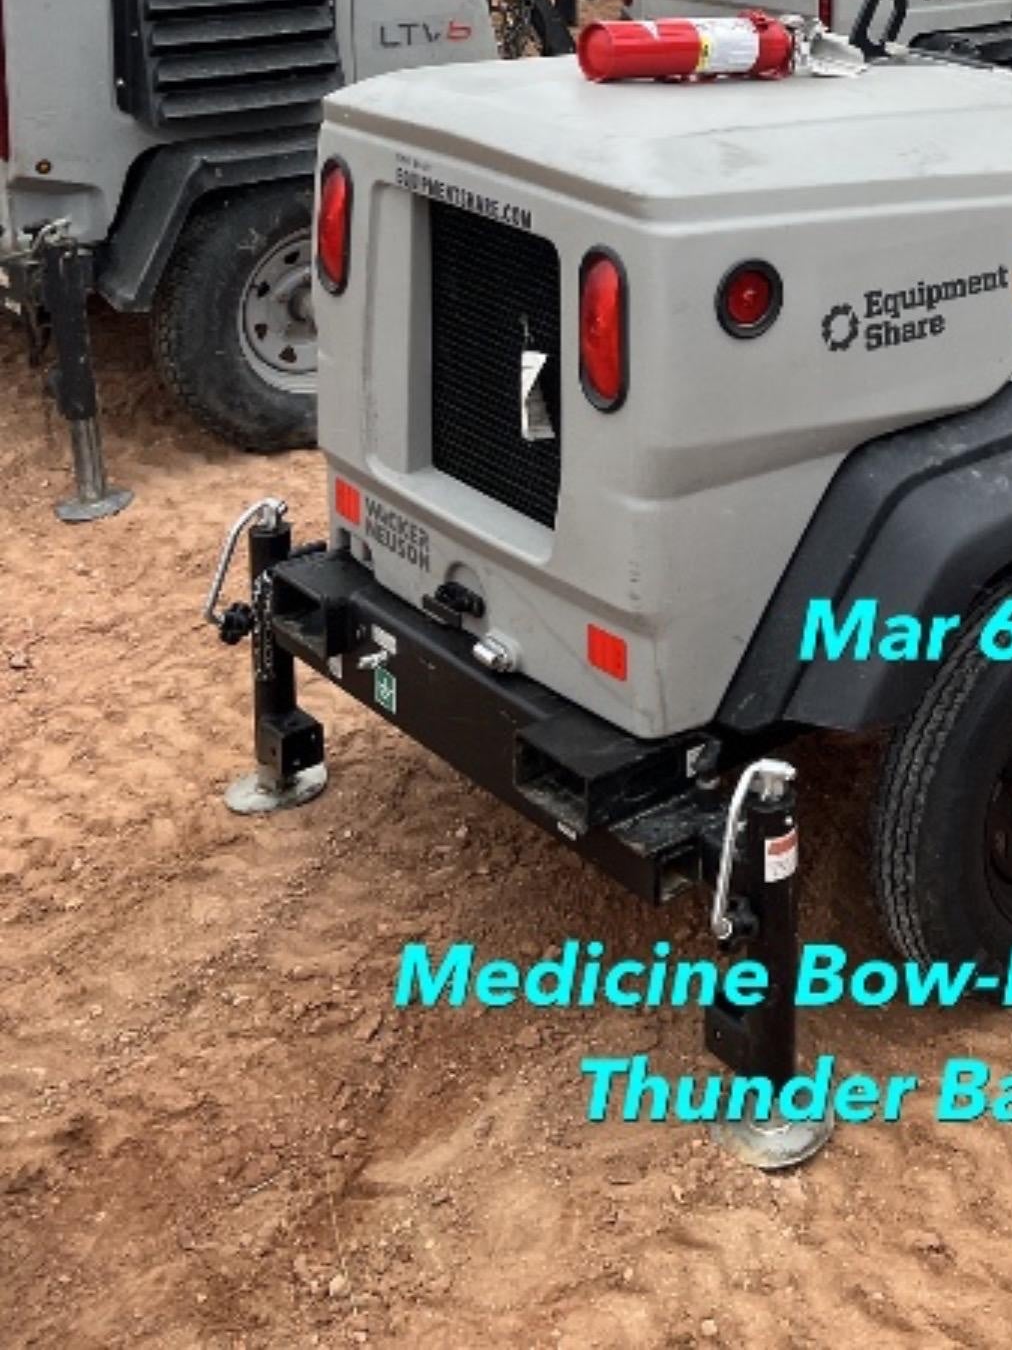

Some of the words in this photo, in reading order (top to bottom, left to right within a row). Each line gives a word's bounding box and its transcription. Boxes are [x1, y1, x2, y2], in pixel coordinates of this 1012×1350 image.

[863, 265, 1009, 319] Equipment
[865, 312, 946, 350] Share
[365, 496, 429, 552] WACKER
[365, 517, 430, 573] NEUSON
